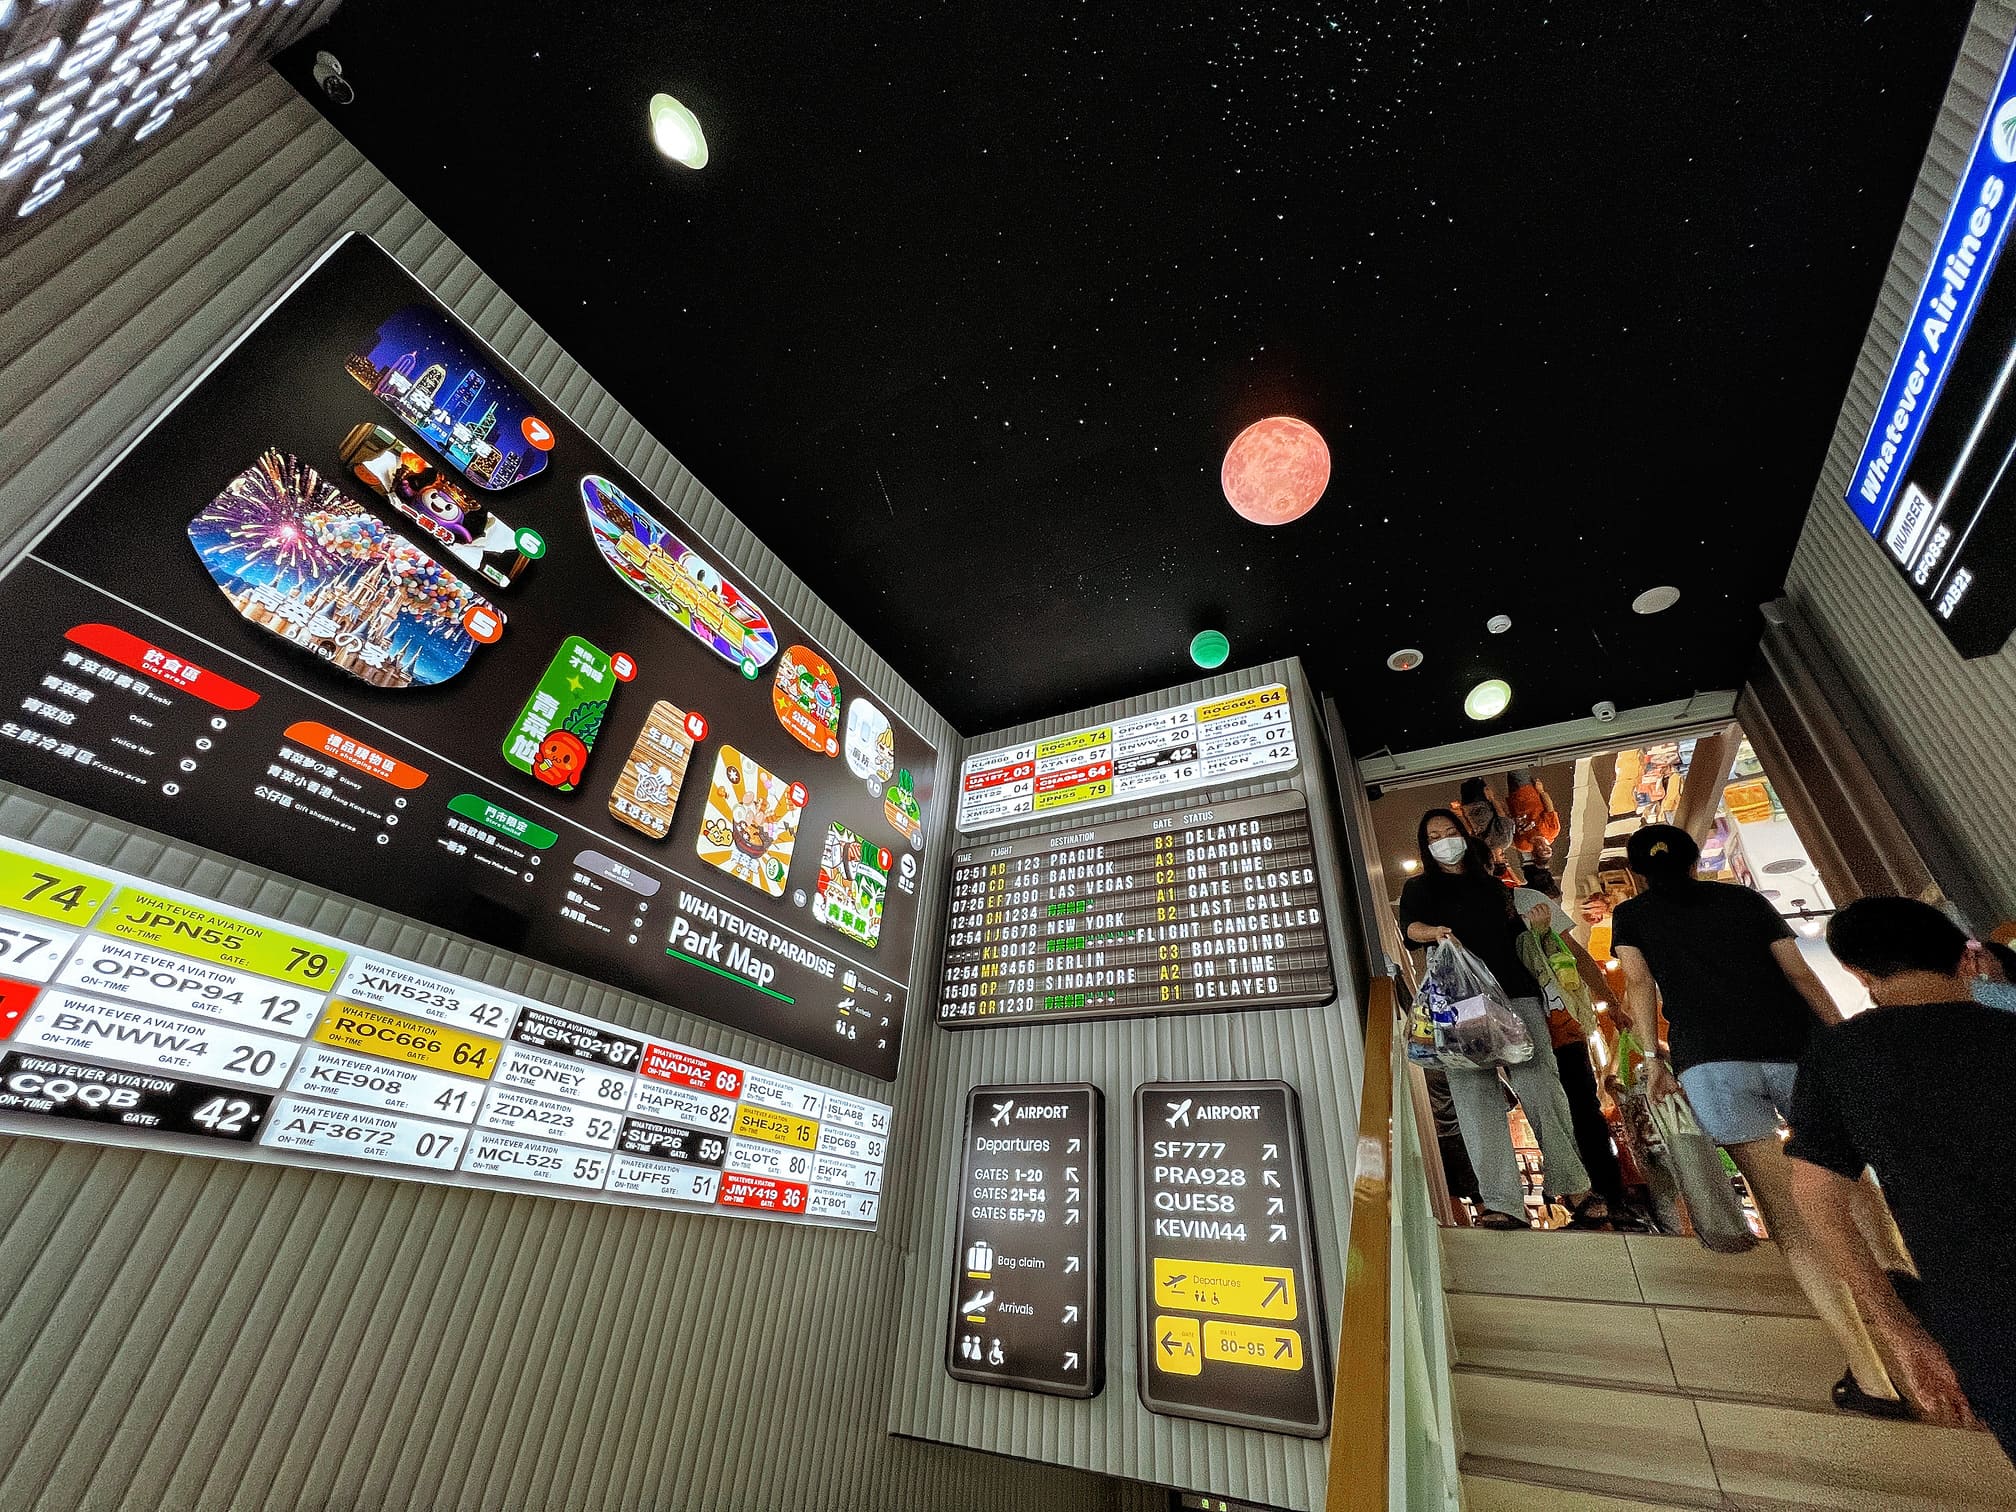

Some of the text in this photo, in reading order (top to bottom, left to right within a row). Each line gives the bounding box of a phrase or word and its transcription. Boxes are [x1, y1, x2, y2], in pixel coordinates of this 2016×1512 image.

[1859, 174, 2005, 505] Whatever Airlines
[530, 421, 550, 441] 7
[1893, 495, 1925, 554] NUMBER
[520, 532, 540, 555] 6
[469, 610, 498, 637] 5
[286, 629, 336, 661] Disney
[143, 649, 201, 682] 飲食區
[613, 655, 633, 678] 3
[1260, 691, 1281, 704] 64
[690, 715, 704, 738] 4
[1263, 709, 1282, 721] 41
[1089, 731, 1106, 743] 74
[1266, 728, 1286, 741] 07
[1269, 746, 1290, 759] 42
[1153, 818, 1172, 829] GATE
[1183, 811, 1214, 824] STATUS
[1017, 820, 1259, 871] 123 PRAGUE B3 DELAYED
[1050, 831, 1095, 847] DESTINATION
[957, 852, 972, 863] TIME
[990, 845, 1013, 858] FLIGHT
[956, 836, 1273, 898] 12:40 BANGKOK A3 BOARDING
[1050, 856, 1263, 900] LAS VEGAS C2 ON TIME
[22, 872, 87, 912] 74
[1157, 868, 1314, 903] A1 GATE CLOSED
[136, 895, 264, 939] WHATEVER AVIATION
[952, 913, 983, 930] 12:40
[1047, 891, 1291, 935] NEW YORK B2 LAST CALL
[126, 911, 244, 950] JPN55
[679, 890, 837, 979] WHATEVER PARADISE
[1136, 908, 1320, 944] FLIGHT CANCELLED
[284, 947, 328, 978] 79
[668, 916, 776, 988] Park Map
[1046, 933, 1285, 971] BERLIN C3 BOARDING
[102, 944, 236, 985] WHATEVER AVIATION
[1046, 955, 1275, 991] SINGAPORE A2 ON TIME
[93, 958, 244, 1005] OPOP94
[356, 972, 461, 1011] XM5233
[1161, 977, 1278, 1001] B1 DELAYED
[63, 1000, 206, 1037] WHATEVER AVIATION
[260, 995, 301, 1026] 12
[469, 1003, 502, 1028] 42
[51, 1013, 209, 1056] BNWW4
[335, 1018, 442, 1053] ROC666
[525, 1019, 608, 1055] MGK1021
[223, 1045, 276, 1077] 20
[452, 1042, 487, 1069] 64
[608, 1040, 638, 1065] 87
[20, 1057, 175, 1093] WHATEVER AVIATION
[310, 1065, 402, 1094] KE908
[510, 1060, 586, 1087] MONEY
[650, 1055, 711, 1081] INADIA2
[9, 1073, 141, 1109] CQQB
[598, 1078, 624, 1101] 88
[715, 1070, 737, 1092] 68
[748, 1083, 783, 1099] RCUE
[434, 1088, 468, 1114] 41
[640, 1092, 709, 1116] HAPR216
[802, 1094, 817, 1112] 77
[828, 1104, 863, 1121] ISLA88
[1016, 1105, 1069, 1119] AIRPORT
[1196, 1105, 1261, 1120] AIRPORT
[192, 1097, 251, 1132] 42
[492, 1102, 574, 1128] ZDA223
[709, 1104, 730, 1124] 82
[742, 1116, 790, 1134] SHEJ23
[871, 1113, 885, 1130] 54
[283, 1118, 396, 1146] AF3672
[586, 1117, 613, 1141] 52
[629, 1130, 682, 1149] SUP26
[796, 1124, 811, 1142] 15
[415, 1132, 454, 1159] 07
[699, 1138, 723, 1161] 59
[823, 1134, 857, 1149] EDC69
[868, 1141, 881, 1157] 93
[976, 1137, 1051, 1155] Departures
[1154, 1140, 1226, 1159] SF777
[476, 1146, 563, 1170] MCL525
[573, 1158, 602, 1180] 55
[734, 1150, 779, 1166] CLOTC
[789, 1156, 806, 1174] 80
[618, 1168, 670, 1185] LUFF5
[818, 1165, 848, 1178] EKI74
[864, 1170, 876, 1186] 17
[974, 1168, 1043, 1182] GATES 1-20
[1155, 1166, 1247, 1186] PRA928
[692, 1175, 711, 1196] 51
[726, 1184, 778, 1200] JMY419
[973, 1187, 1008, 1200] GATES
[782, 1188, 800, 1208] 36
[812, 1197, 847, 1208] AT801
[859, 1199, 874, 1216] 47
[1155, 1191, 1236, 1213] QUES8
[971, 1206, 1007, 1220] GATES
[1156, 1218, 1247, 1241] KEVIM44
[998, 1256, 1046, 1269] Bag claim
[1193, 1274, 1241, 1289] Departures
[998, 1301, 1034, 1316] Arrivals
[1183, 1342, 1195, 1357] A
[1220, 1338, 1266, 1358] 80-95
